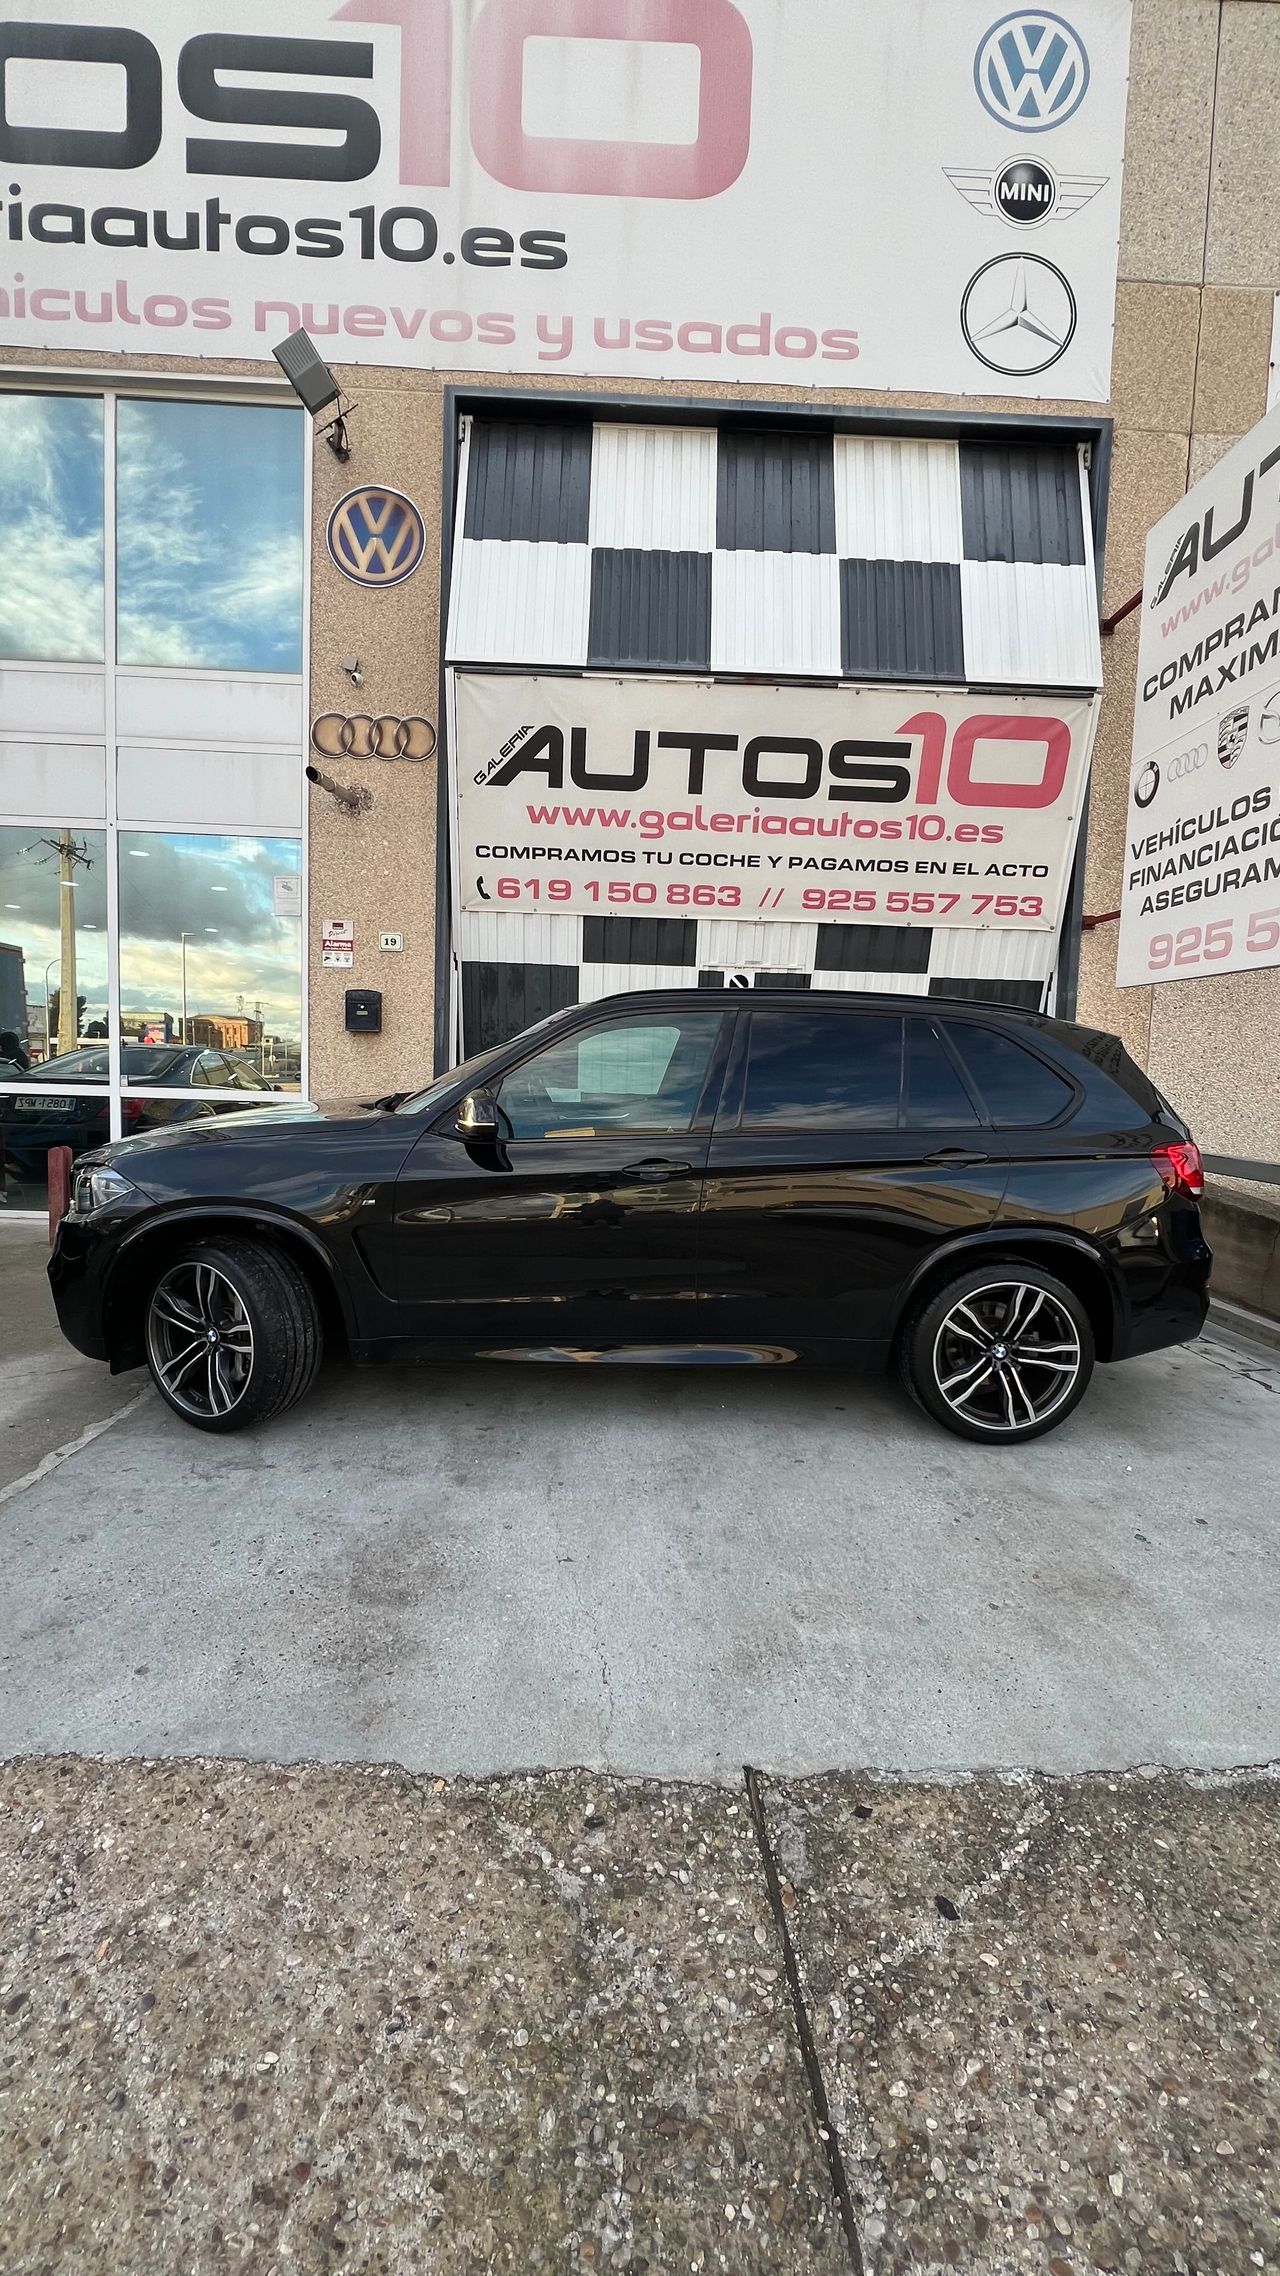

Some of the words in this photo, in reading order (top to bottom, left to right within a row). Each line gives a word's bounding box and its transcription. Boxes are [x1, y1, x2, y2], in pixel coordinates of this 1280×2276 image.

[1001, 181, 1050, 202] MINI
[0, 183, 568, 269] iaautos10.es
[0, 272, 232, 330] iculos
[254, 300, 516, 345] nuevos
[537, 314, 573, 360] y
[594, 312, 860, 361] usados
[473, 725, 535, 785] GALERIA
[485, 711, 1072, 809] AUTOS10
[526, 804, 1004, 844] www.galeriaautos10.es
[1131, 786, 1271, 860] VEHÍCULOS
[475, 845, 636, 864] COMPRAMOS
[642, 851, 673, 865] TU
[679, 852, 760, 868] COCHE
[767, 855, 783, 869] Y
[788, 856, 909, 873] PAGAMOS
[915, 861, 947, 875] EN
[952, 862, 979, 876] EL
[984, 863, 1049, 878] ACTO
[497, 877, 572, 901] 619
[584, 881, 657, 902] 150
[666, 883, 742, 907] 863
[802, 888, 877, 911] 925
[886, 891, 961, 914] 557
[971, 894, 1043, 917] 753
[324, 940, 352, 948] Alarma
[384, 937, 397, 946] 19
[1148, 919, 1233, 970] 925
